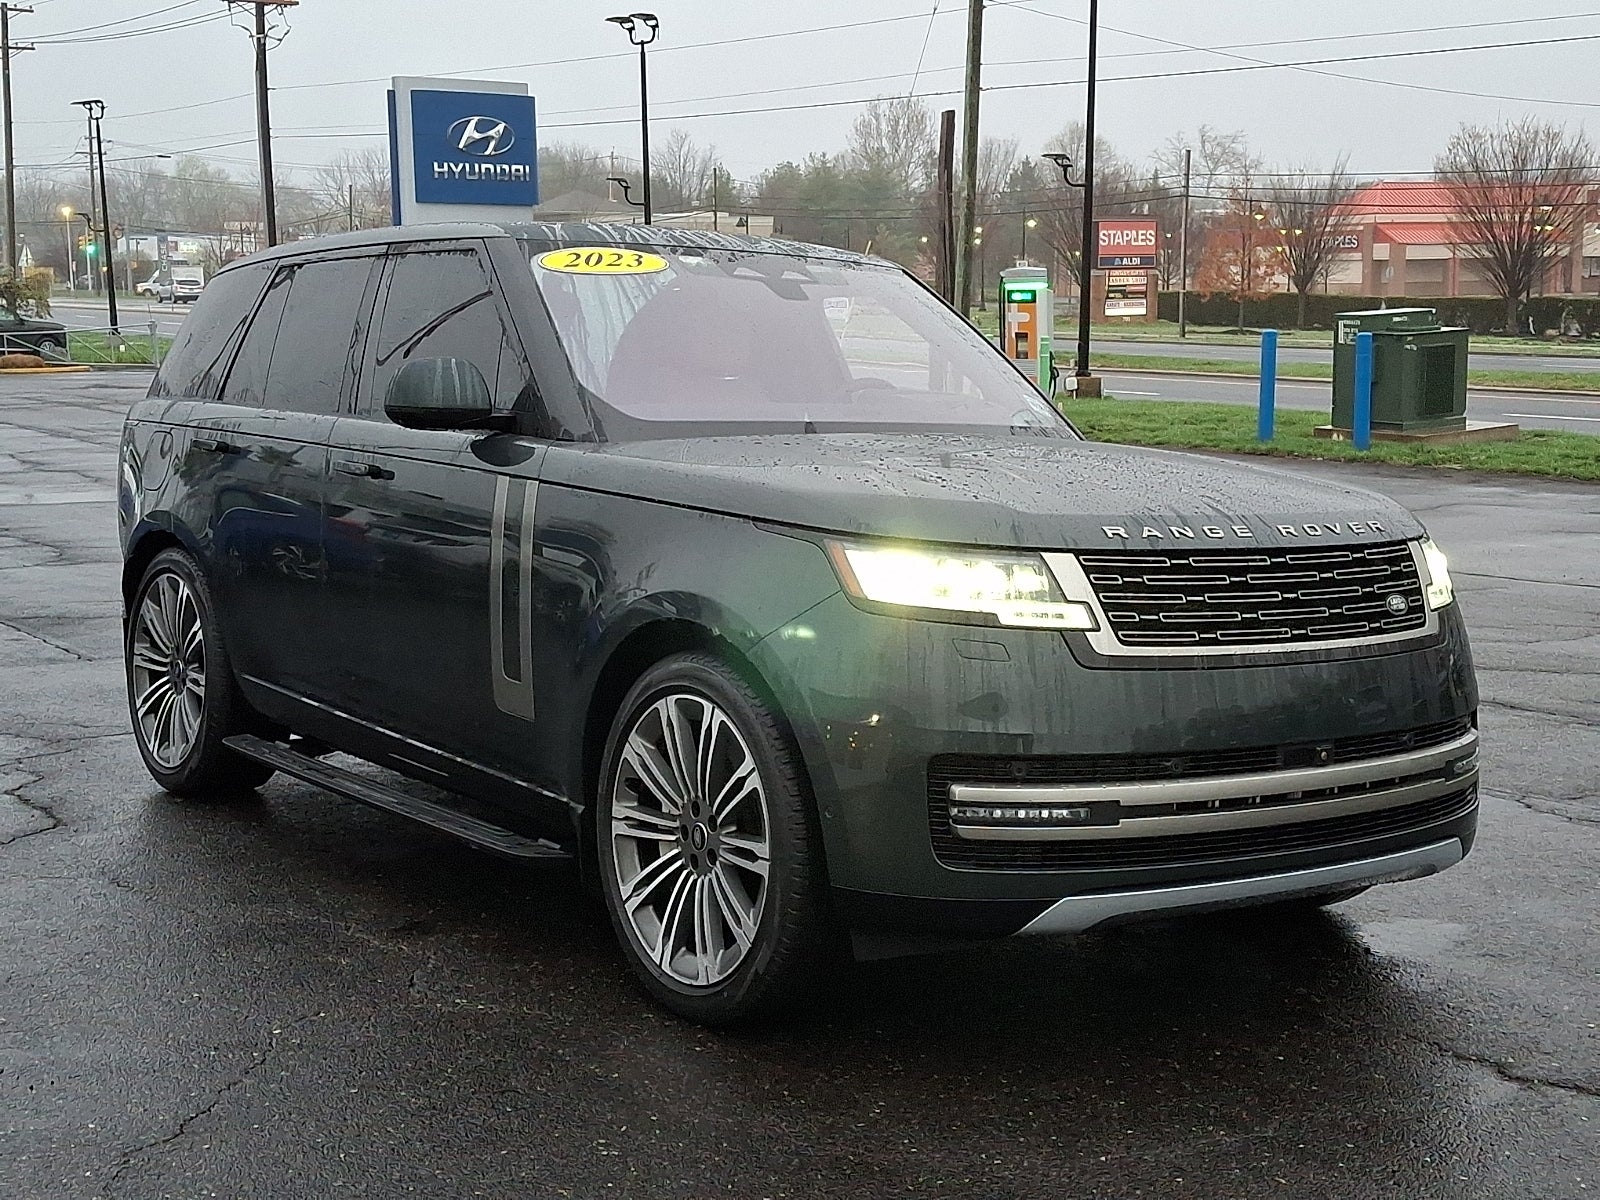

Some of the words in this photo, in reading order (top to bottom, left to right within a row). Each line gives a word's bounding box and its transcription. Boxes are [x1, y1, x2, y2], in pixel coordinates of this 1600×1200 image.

[433, 161, 530, 182] HYUNDAI
[1099, 229, 1156, 246] STAPLES
[564, 251, 644, 268] 2023
[1122, 257, 1141, 266] ALDI
[1101, 525, 1254, 539] RANGE
[1275, 520, 1387, 538] ROVER
